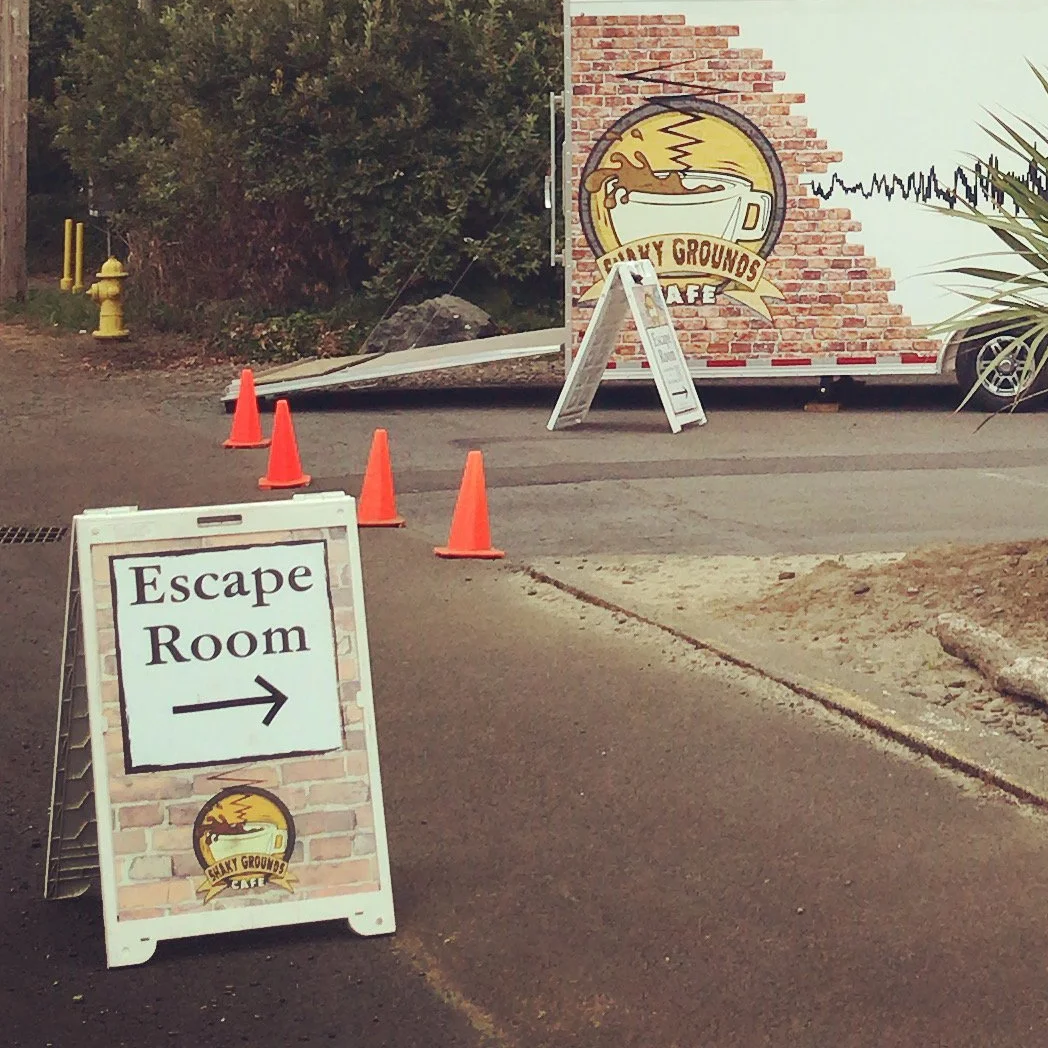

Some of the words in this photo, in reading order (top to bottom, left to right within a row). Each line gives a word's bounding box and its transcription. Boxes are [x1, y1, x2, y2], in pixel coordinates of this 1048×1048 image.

[672, 238, 761, 282] GROUNDS
[662, 283, 718, 305] AFE
[129, 564, 314, 608] Escape
[143, 622, 311, 667] Room
[207, 857, 237, 882] SHAKY
[241, 855, 286, 875] GROUNDS
[230, 877, 266, 890] CAFE
